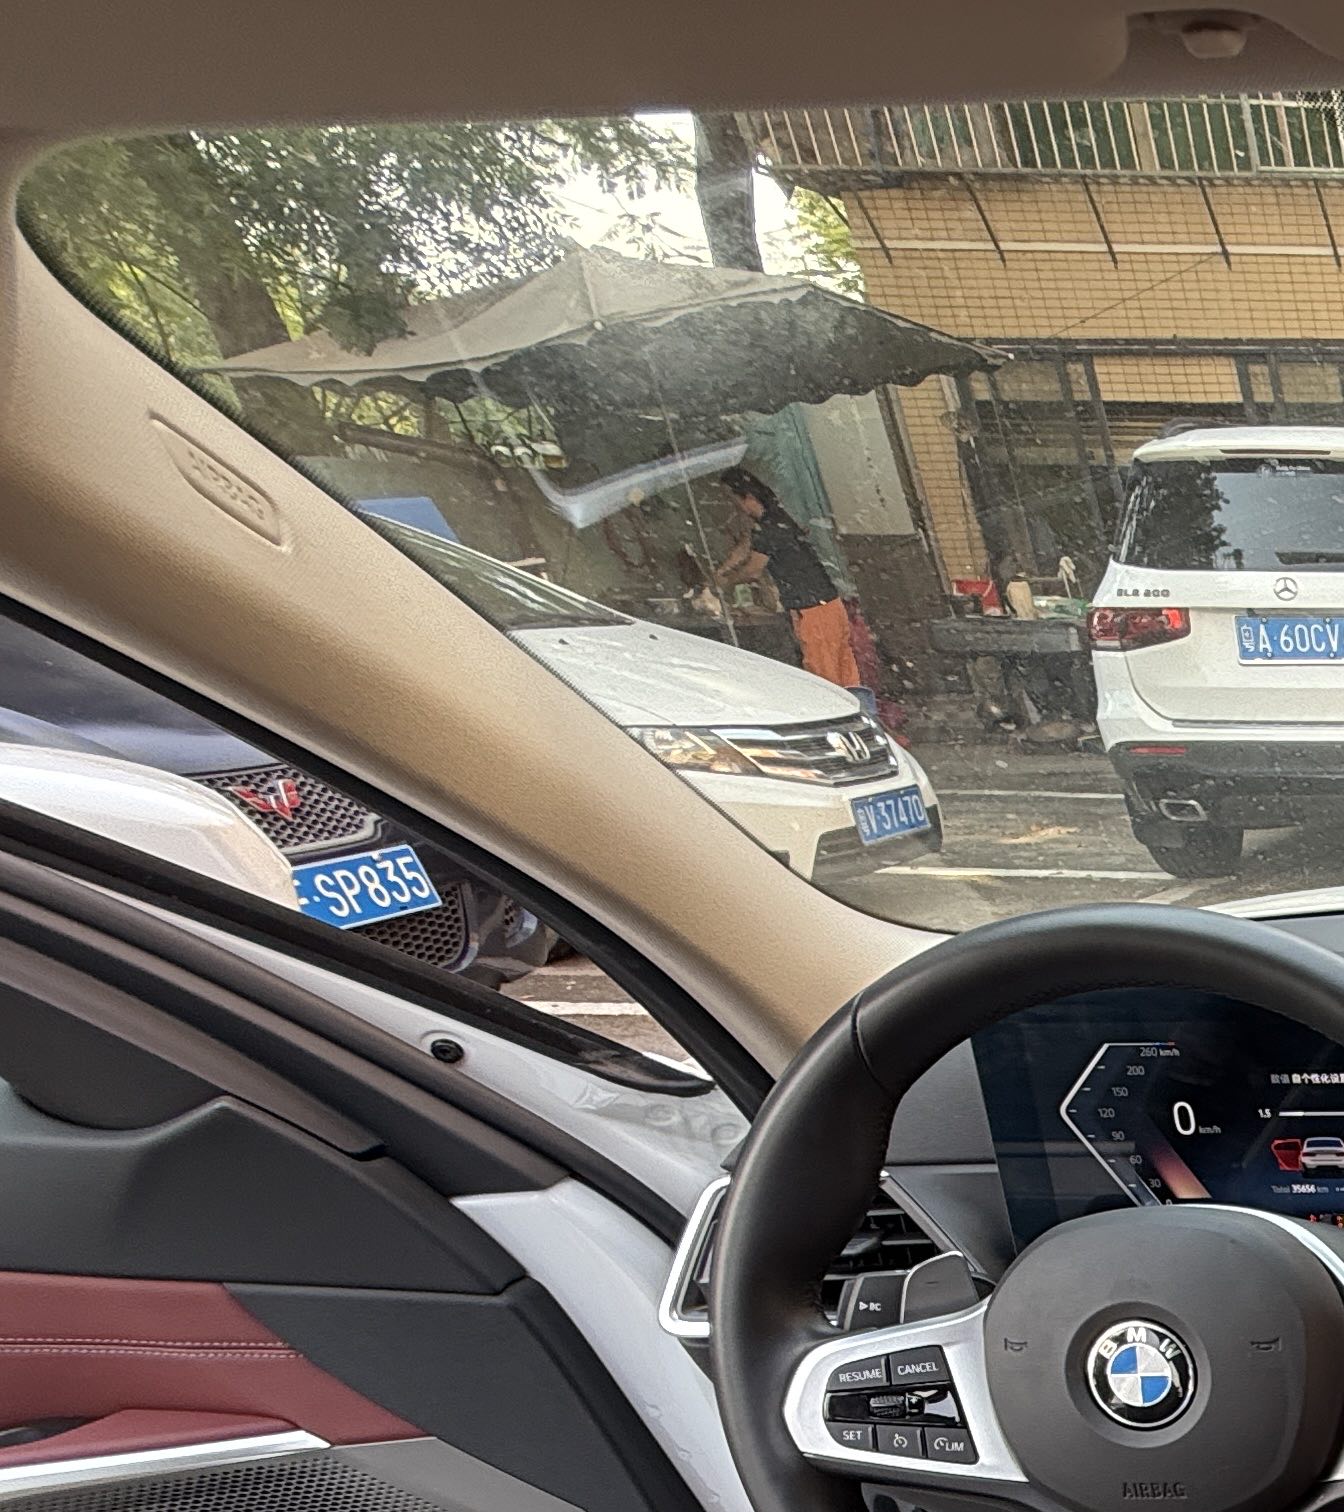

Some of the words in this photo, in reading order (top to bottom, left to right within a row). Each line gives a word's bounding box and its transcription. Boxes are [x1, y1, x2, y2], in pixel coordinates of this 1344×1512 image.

[1126, 1065, 1145, 1076] 200
[1112, 1087, 1129, 1097] 150
[1098, 1108, 1115, 1118] 120
[1173, 1101, 1196, 1136] 0
[1112, 1130, 1125, 1140] 90
[1129, 1154, 1142, 1165] 60
[1149, 1178, 1161, 1188] 30
[1099, 1327, 1182, 1360] BMW
[897, 1361, 939, 1376] CANCEL
[839, 1368, 883, 1383] RESUME
[842, 1430, 863, 1441] SET
[946, 1441, 964, 1452] LIM
[1121, 1481, 1188, 1500] AIRBAG
